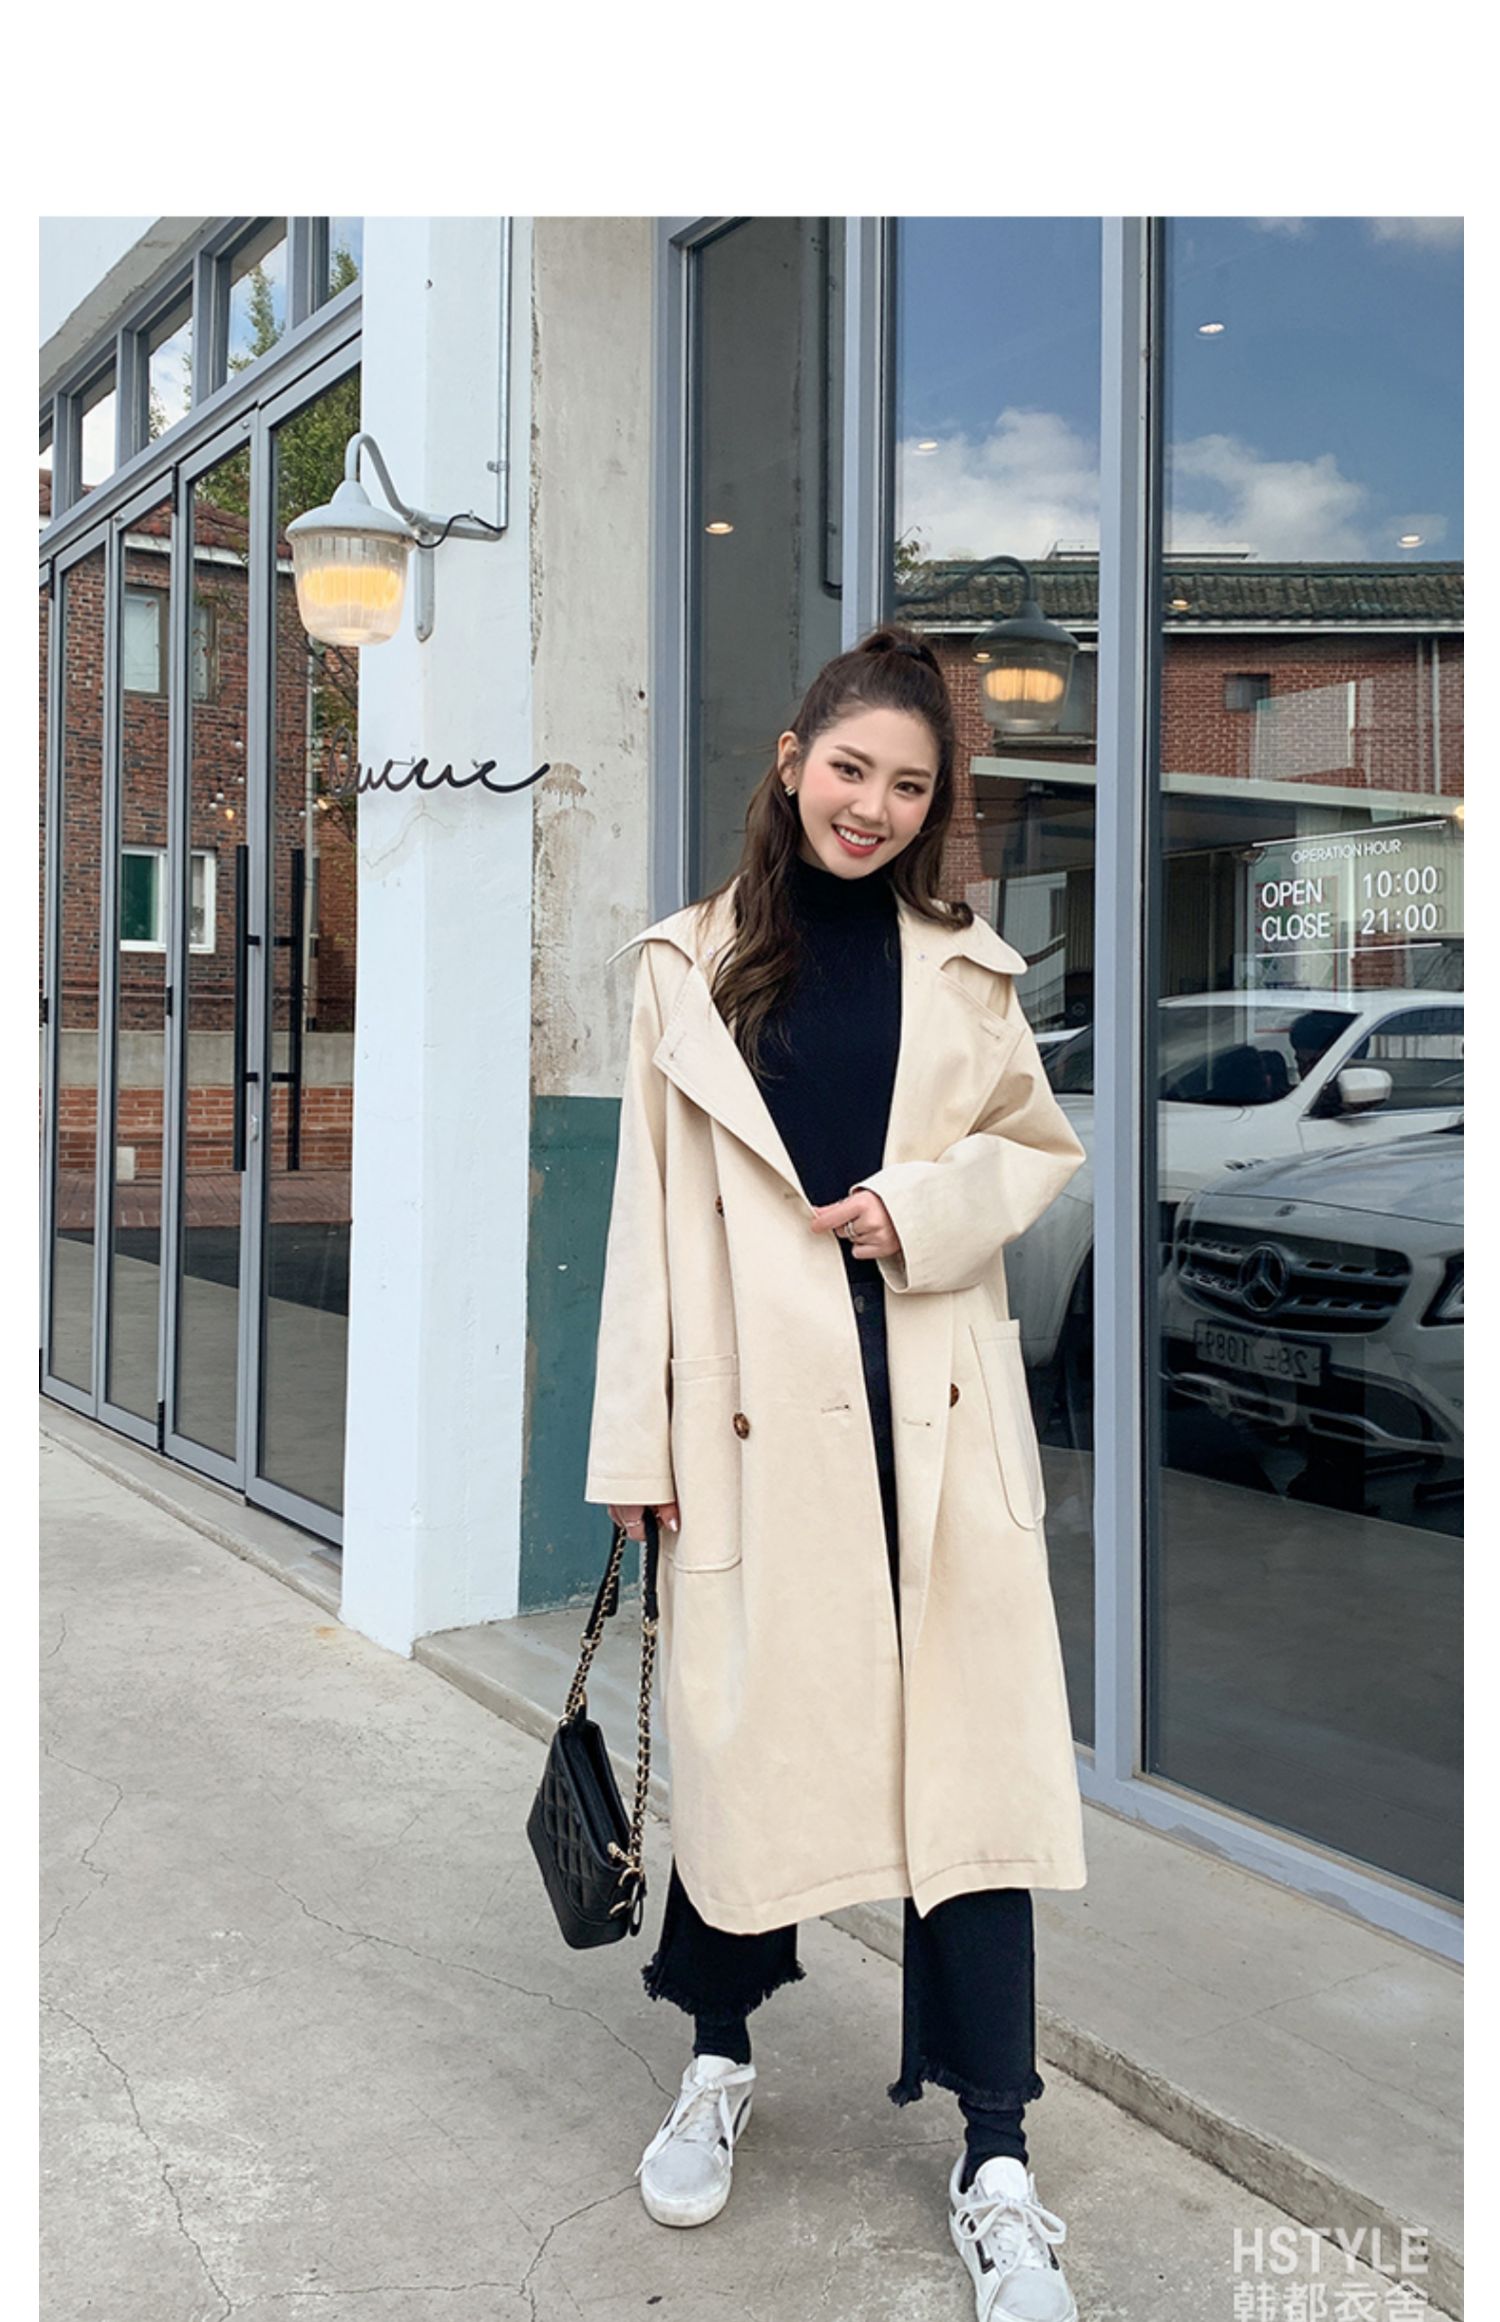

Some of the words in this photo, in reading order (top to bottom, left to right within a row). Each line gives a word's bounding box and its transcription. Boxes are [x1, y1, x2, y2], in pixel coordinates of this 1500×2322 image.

[1291, 844, 1362, 864] OPERATION
[1363, 838, 1401, 856] HOUR
[1261, 877, 1323, 908] OPEN
[1363, 865, 1438, 899] 10:00
[1261, 911, 1331, 942] CLOSE
[1361, 902, 1438, 935] 21:00
